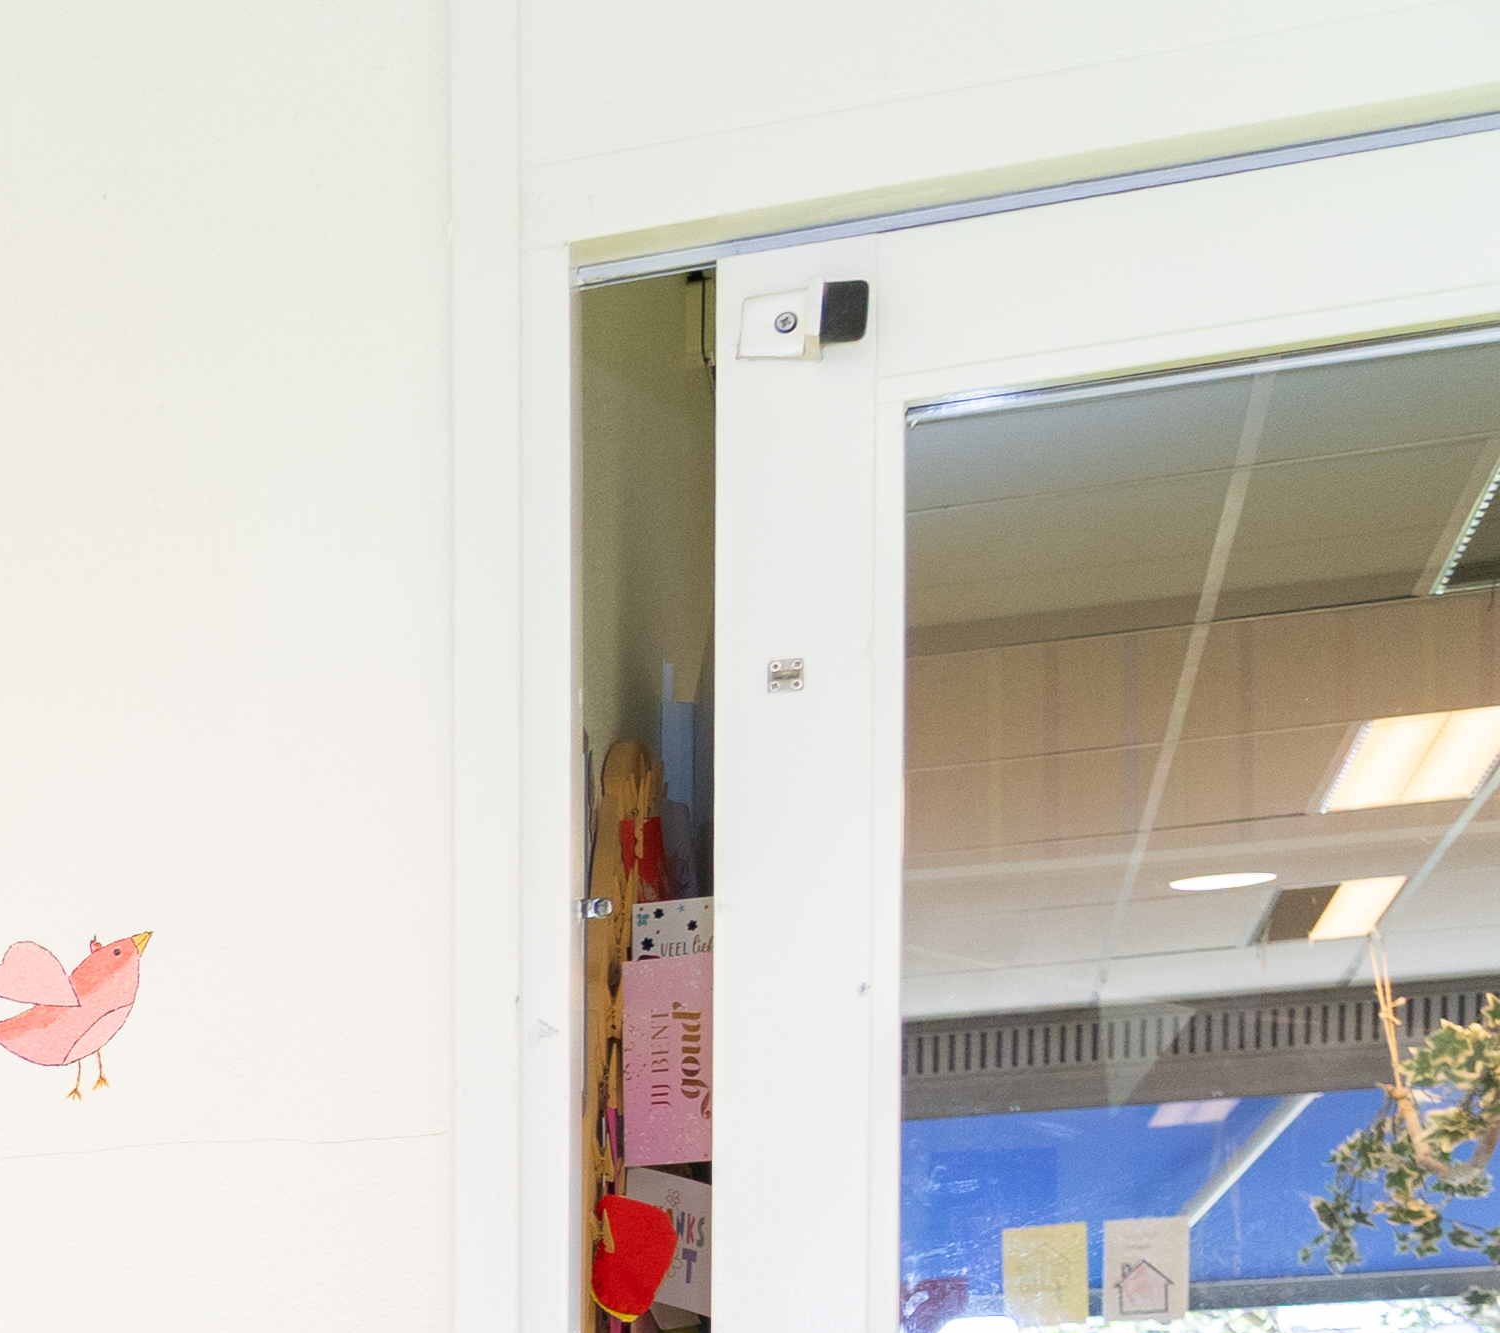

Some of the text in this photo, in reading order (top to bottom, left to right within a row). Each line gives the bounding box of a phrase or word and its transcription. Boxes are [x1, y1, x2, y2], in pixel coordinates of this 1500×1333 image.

[660, 941, 689, 957] VEEL
[650, 1011, 672, 1107] JIJ BENT
